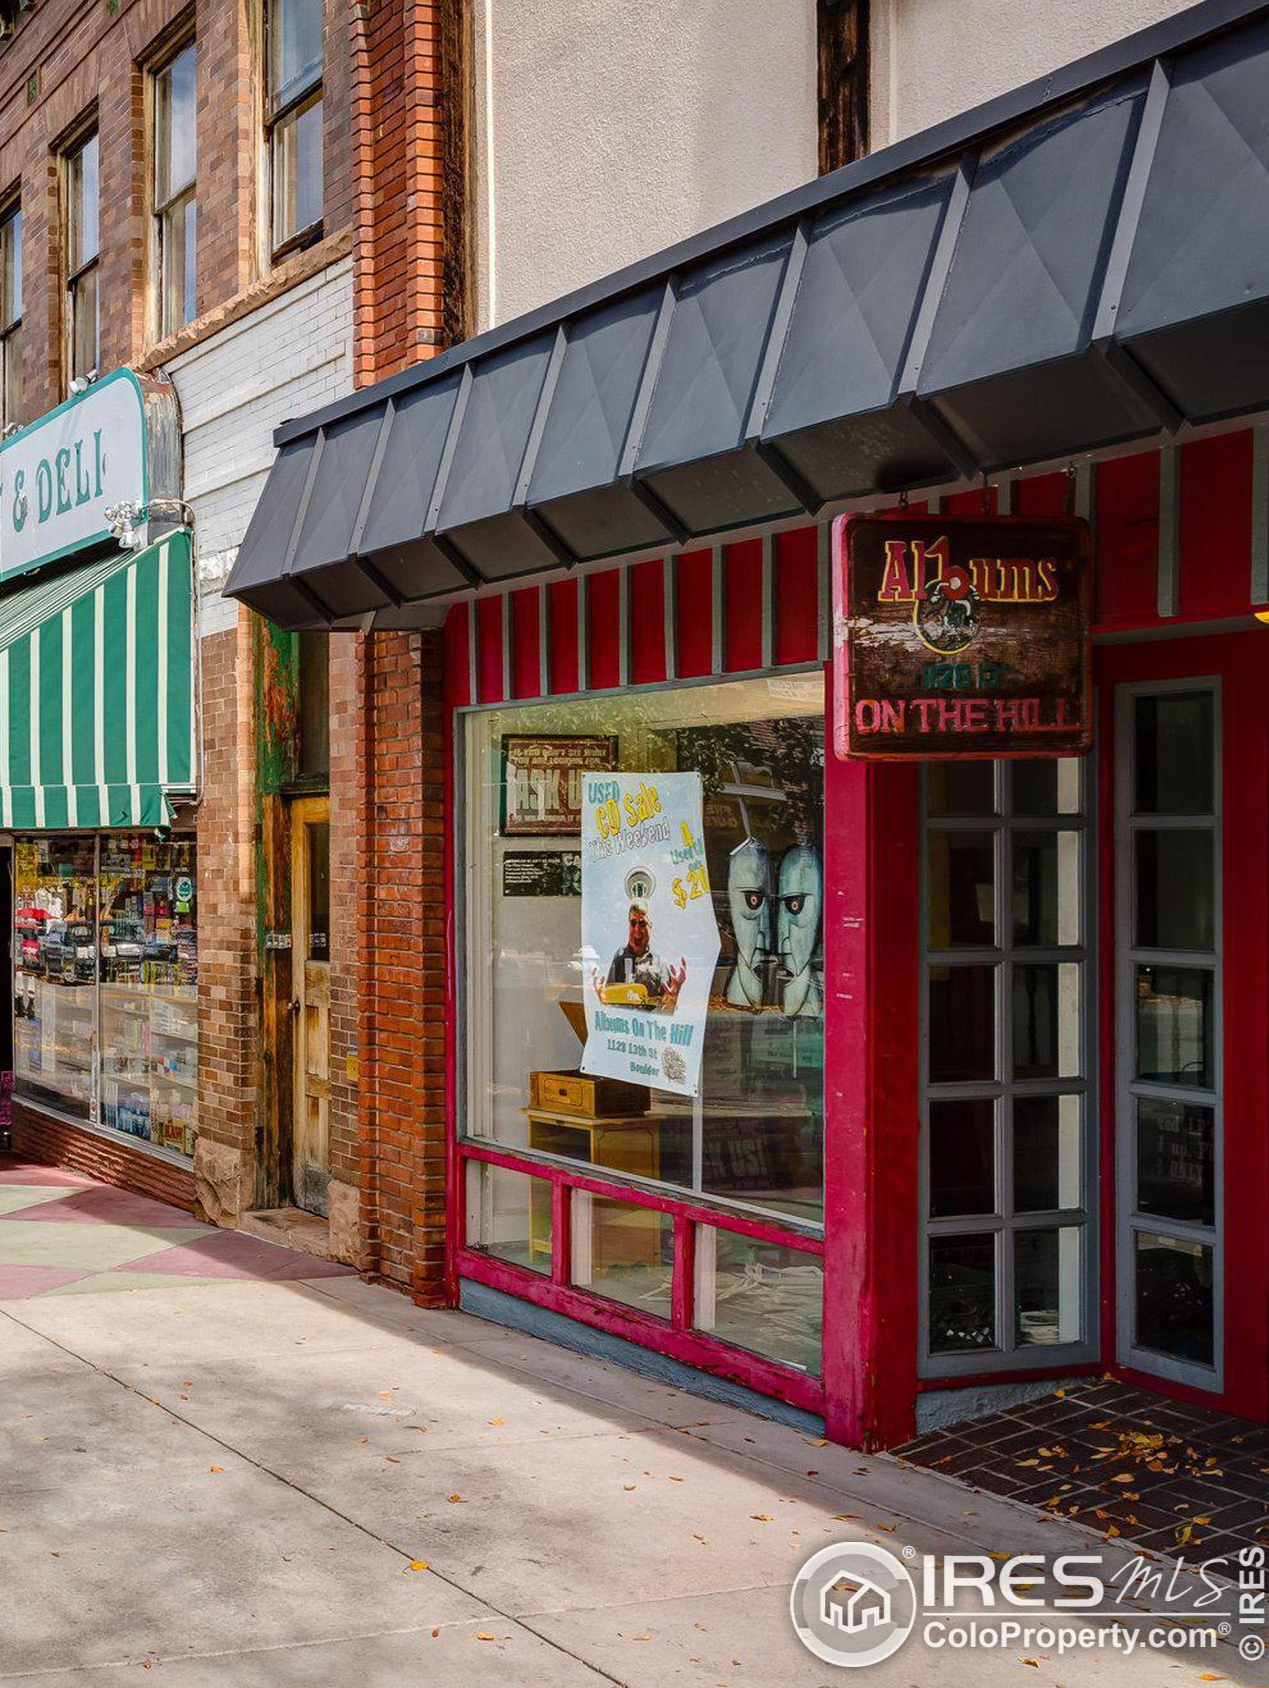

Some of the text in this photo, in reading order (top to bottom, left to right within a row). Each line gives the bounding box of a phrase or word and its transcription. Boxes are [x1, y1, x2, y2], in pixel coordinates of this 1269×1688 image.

[12, 468, 28, 534] &
[35, 427, 103, 525] DELI
[854, 699, 1082, 733] ON THE HILL
[588, 780, 620, 804] USED
[595, 798, 622, 840] CD
[623, 780, 662, 828] Sale
[613, 816, 671, 856] Weekend
[594, 1010, 694, 1047] Albums On The Hill
